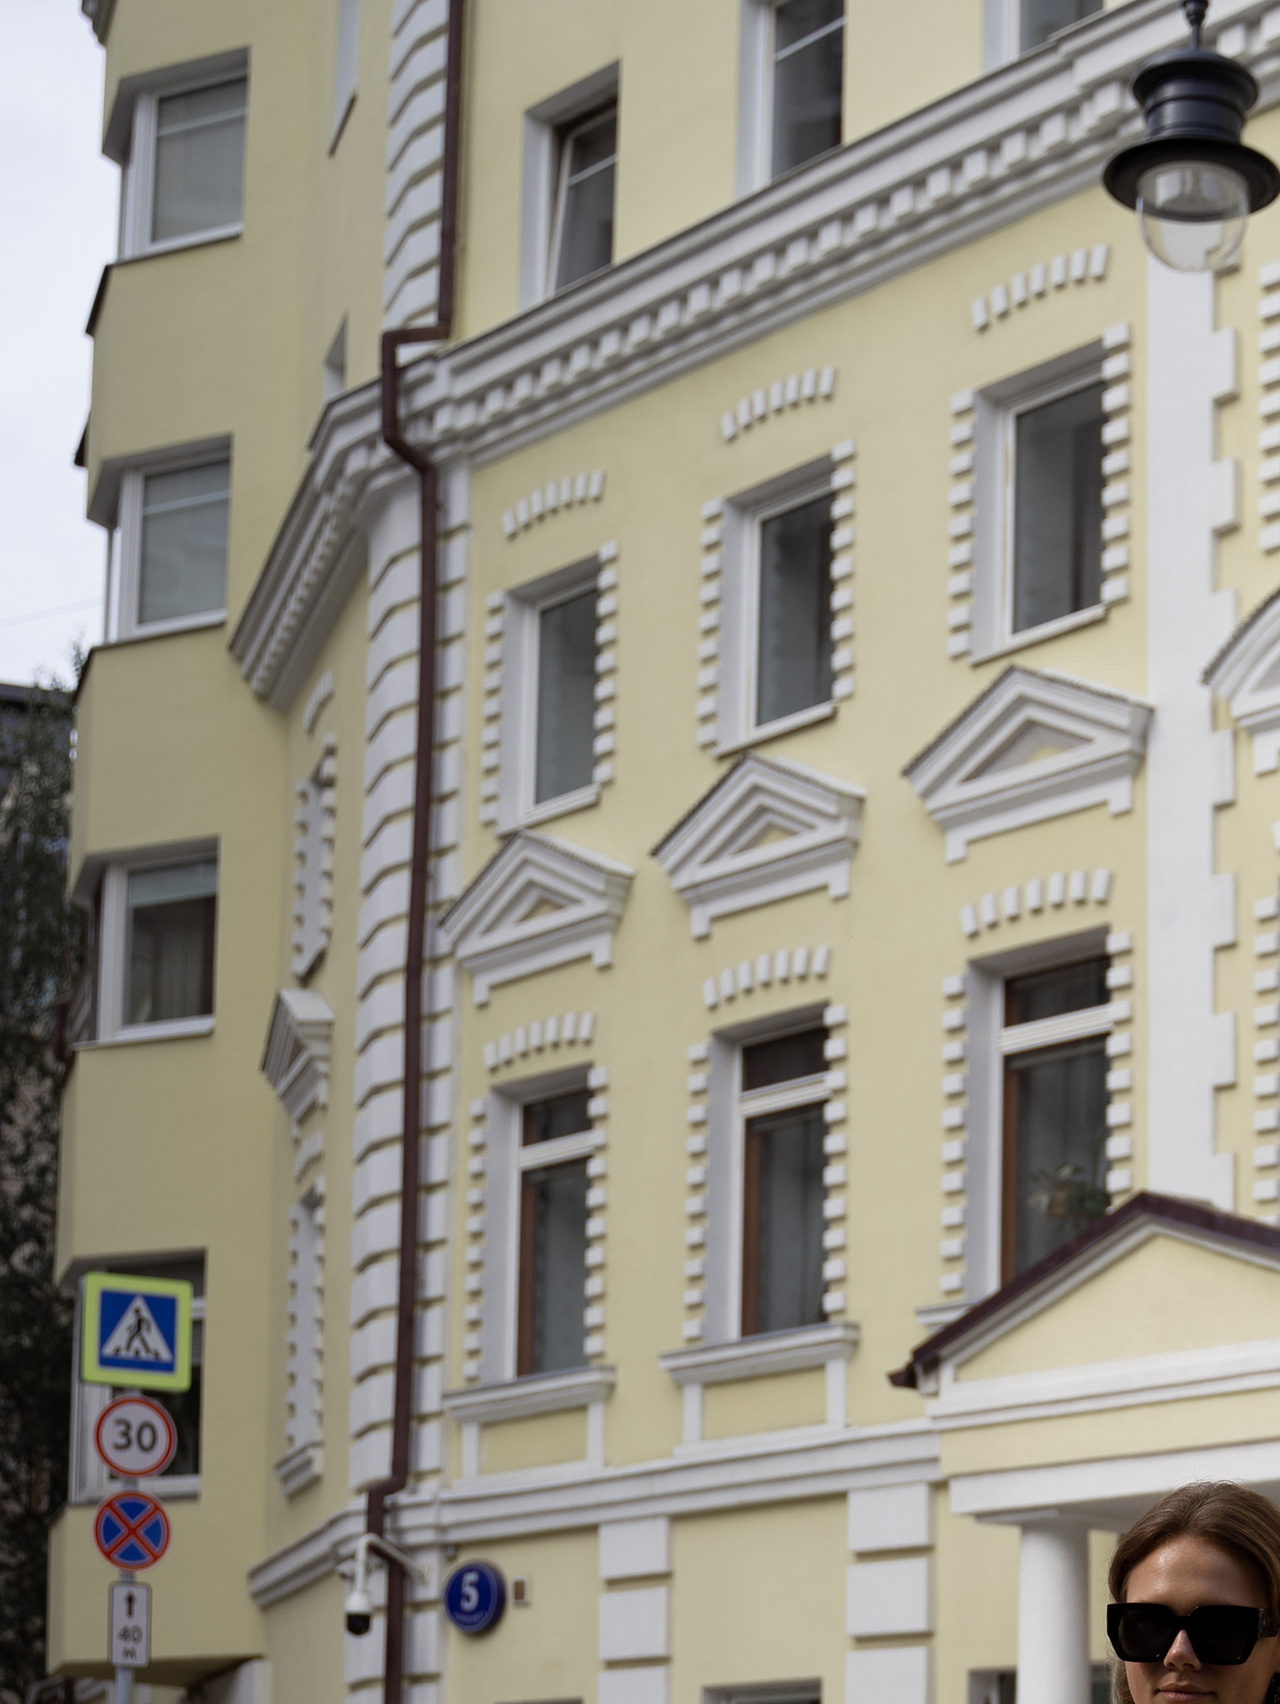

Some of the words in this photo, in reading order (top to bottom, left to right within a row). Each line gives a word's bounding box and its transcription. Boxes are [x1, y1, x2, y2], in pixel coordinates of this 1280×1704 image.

[114, 1418, 157, 1453] 30
[460, 1571, 479, 1611] 5
[118, 1625, 142, 1644] 40
